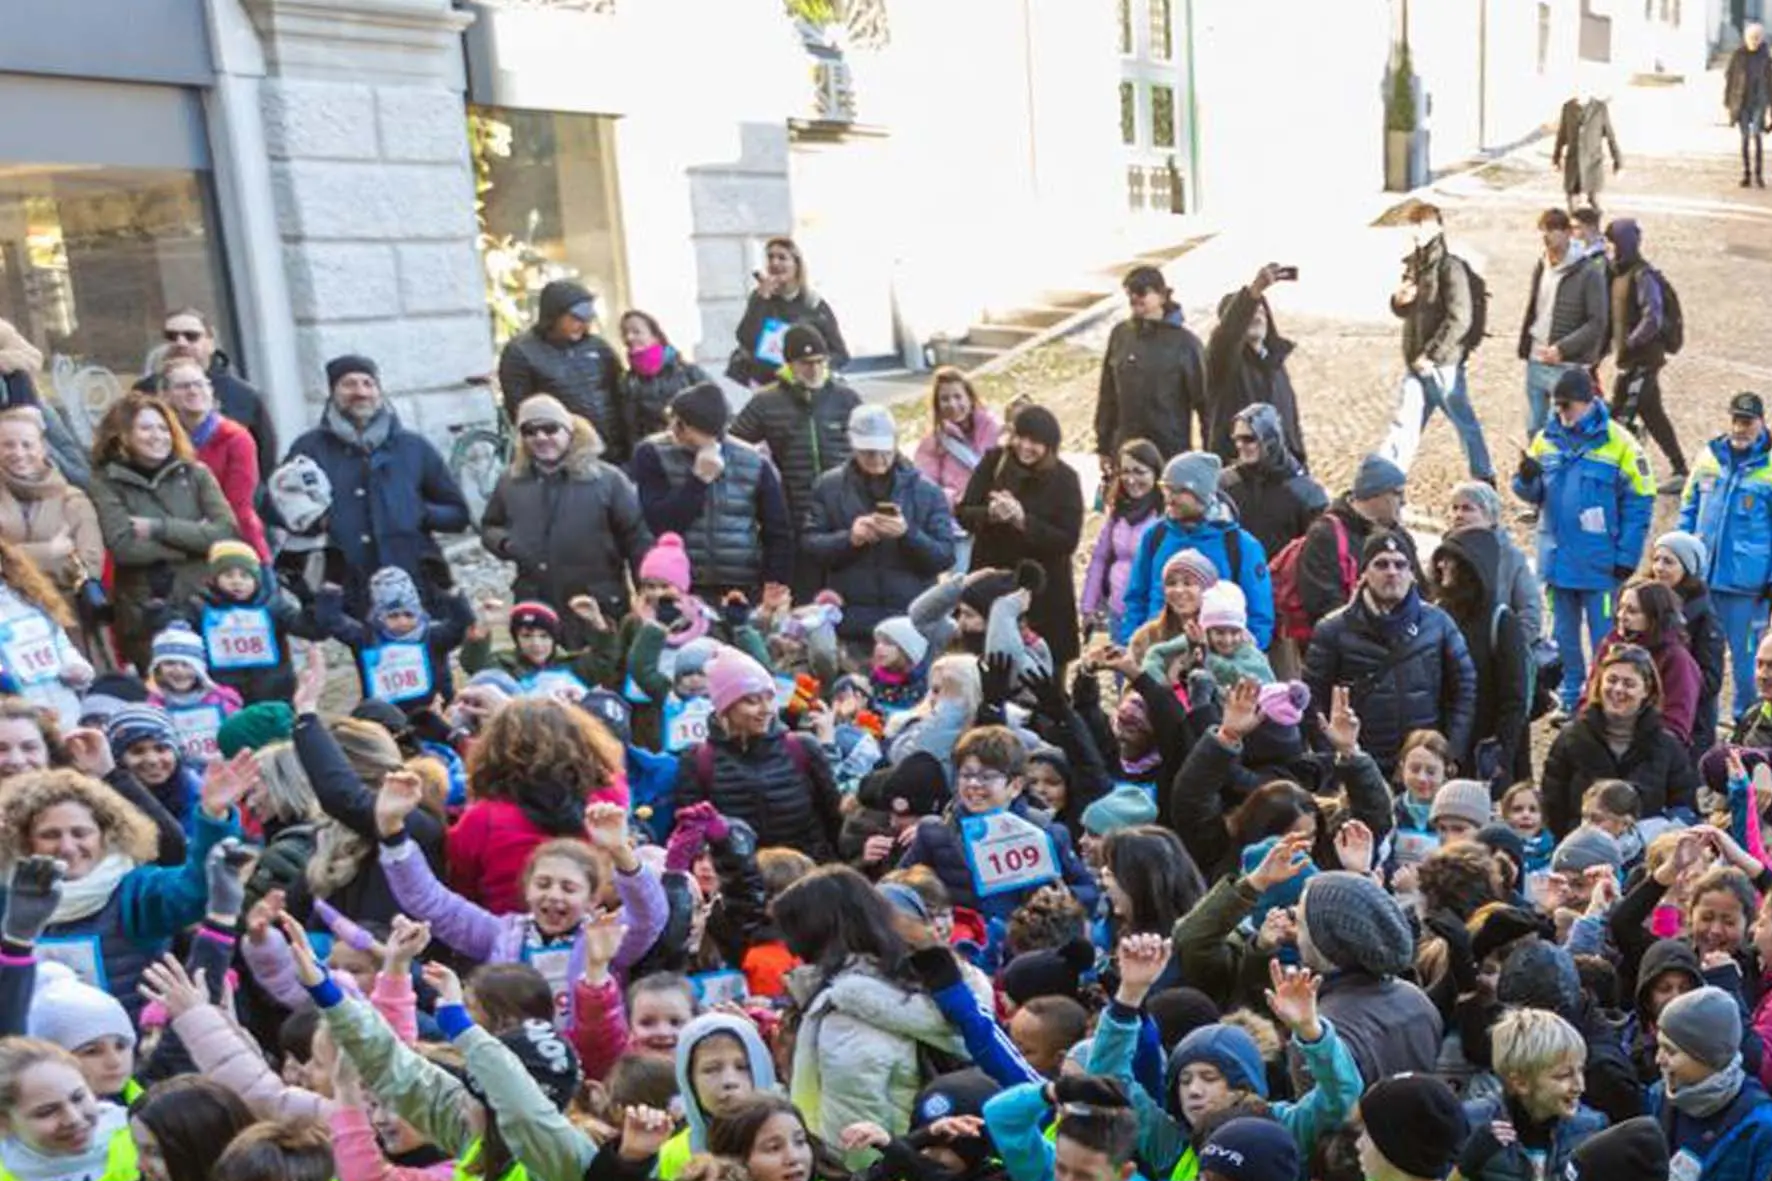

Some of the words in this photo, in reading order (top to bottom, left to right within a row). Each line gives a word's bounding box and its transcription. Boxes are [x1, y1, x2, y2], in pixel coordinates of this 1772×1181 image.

[222, 635, 265, 655] 108
[680, 722, 706, 739] 10
[988, 846, 1041, 876] 109
